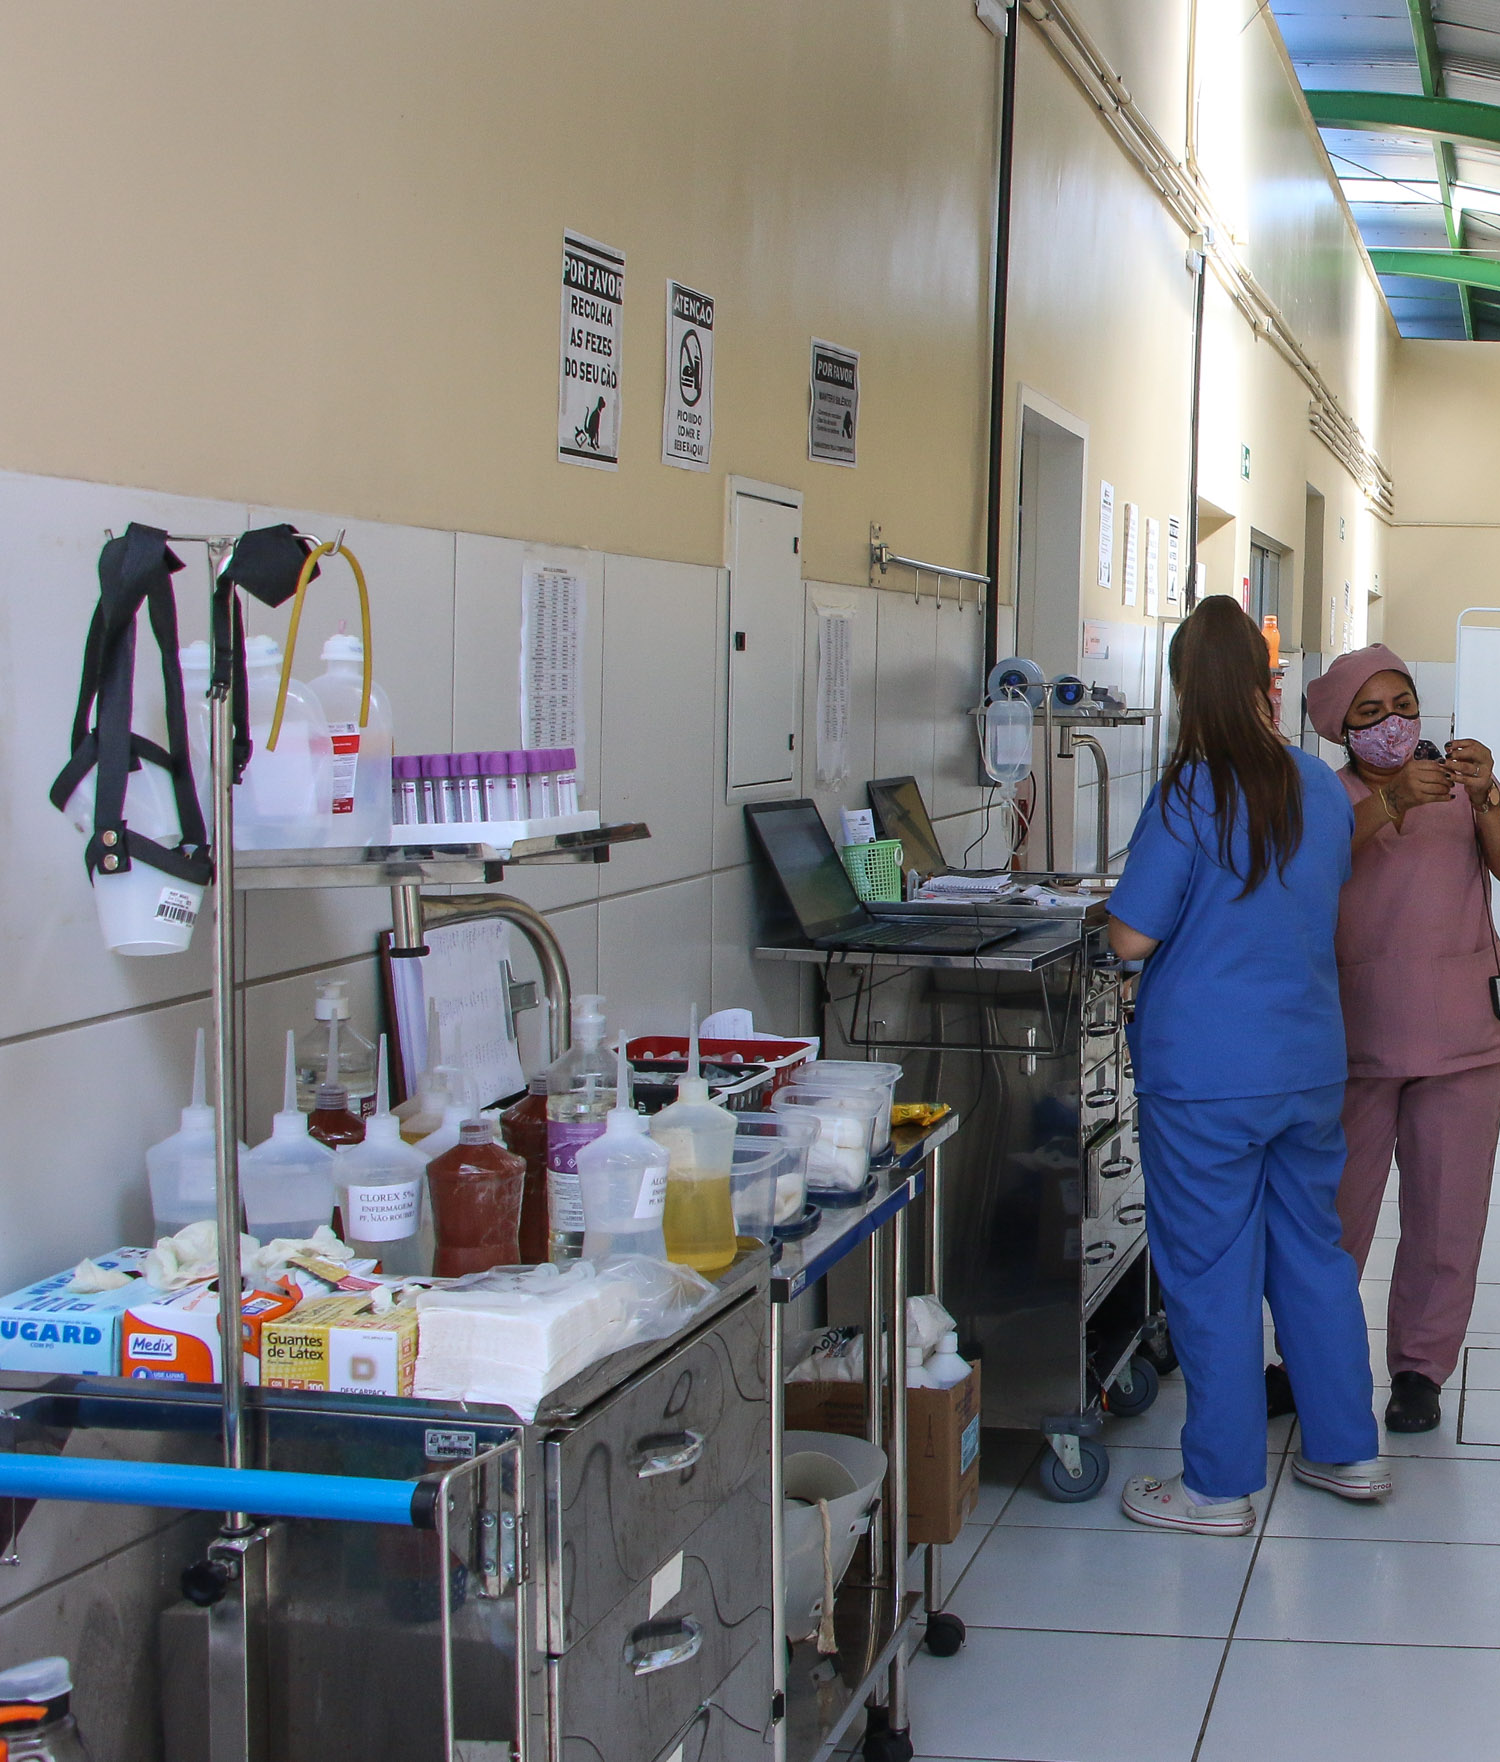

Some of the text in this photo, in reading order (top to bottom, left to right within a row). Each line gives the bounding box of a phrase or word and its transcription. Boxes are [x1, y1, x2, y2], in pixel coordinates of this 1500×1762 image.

[562, 255, 624, 299] POR FAVOR
[571, 294, 613, 327] RECOLHA
[674, 293, 713, 325] ATENÇÃO
[570, 327, 612, 357] AS FEZES
[565, 356, 578, 378] DO
[579, 361, 599, 384] SEU
[817, 360, 853, 384] POR FAVOR
[678, 425, 701, 440] COMER E
[674, 439, 689, 452] BEBER
[360, 1190, 415, 1203] CLOREX 5%
[361, 1202, 413, 1213] ENFERMAGEM
[132, 1337, 172, 1353] Medix
[267, 1332, 323, 1347] Guantes
[267, 1345, 323, 1360] de Látex
